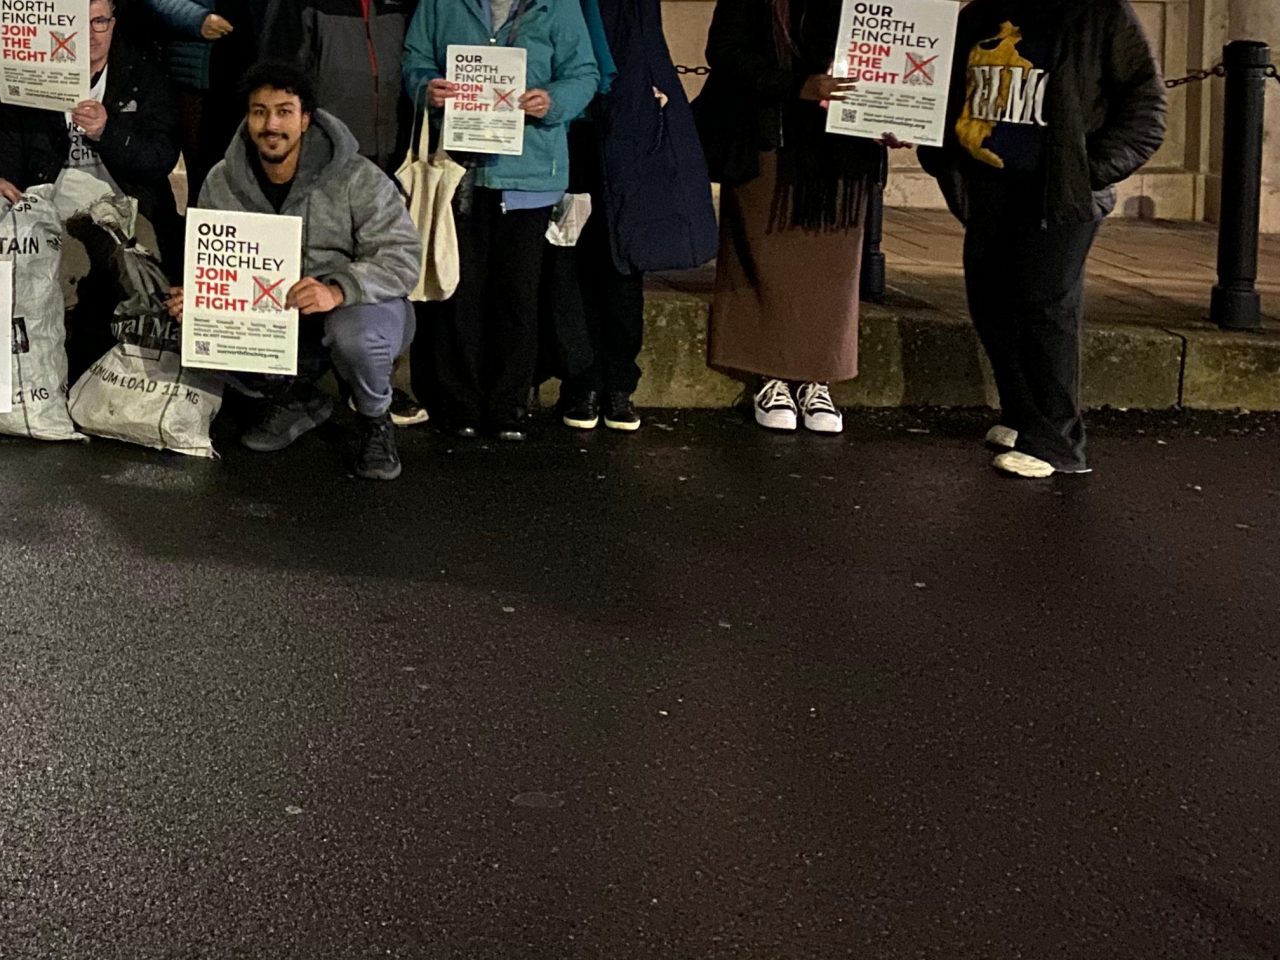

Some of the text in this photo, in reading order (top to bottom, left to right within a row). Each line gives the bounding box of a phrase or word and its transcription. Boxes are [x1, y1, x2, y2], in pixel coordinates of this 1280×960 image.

[1, 0, 54, 13] NORTH
[853, 2, 893, 18] OUR
[1, 13, 76, 27] FINCHLEY
[852, 15, 915, 33] NORTH
[1, 25, 37, 37] JOIN
[1, 37, 32, 49] THE
[850, 28, 939, 50] FINCHLEY
[3, 49, 47, 62] FIGHT
[847, 41, 891, 57] JOIN
[455, 54, 482, 63] OUR
[847, 54, 883, 70] THE
[455, 64, 498, 74] NORTH
[455, 73, 515, 85] FINCHLEY
[453, 102, 491, 112] FIGHT
[198, 223, 237, 238] OUR
[197, 237, 260, 254] NORTH
[197, 252, 284, 272] FINCHLEY
[195, 267, 238, 282] JOIN
[195, 281, 231, 296] THE
[195, 295, 248, 311] FIGHT
[120, 375, 157, 393] LOAD
[30, 387, 49, 402] KG
